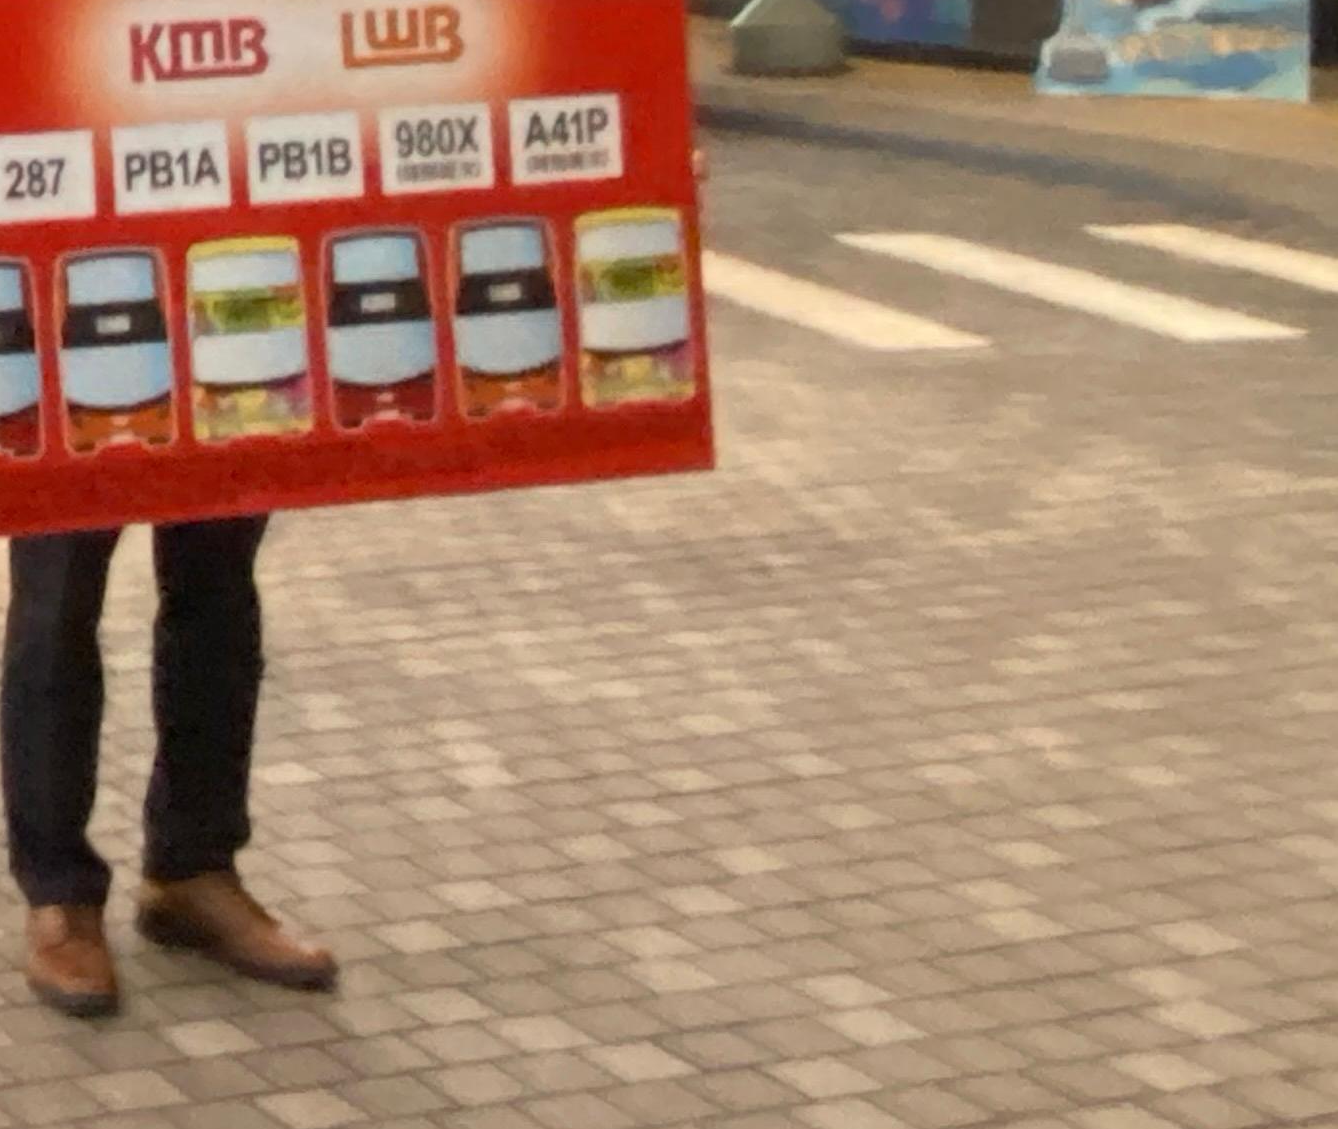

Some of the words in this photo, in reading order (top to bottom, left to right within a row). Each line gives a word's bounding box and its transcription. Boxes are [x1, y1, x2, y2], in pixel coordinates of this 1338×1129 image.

[129, 18, 269, 84] KMB
[340, 4, 465, 70] LWB
[396, 116, 479, 159] 980X
[526, 107, 608, 148] A41P
[3, 158, 66, 200] 287
[125, 148, 221, 192] PB1A
[259, 138, 353, 182] PB1B
